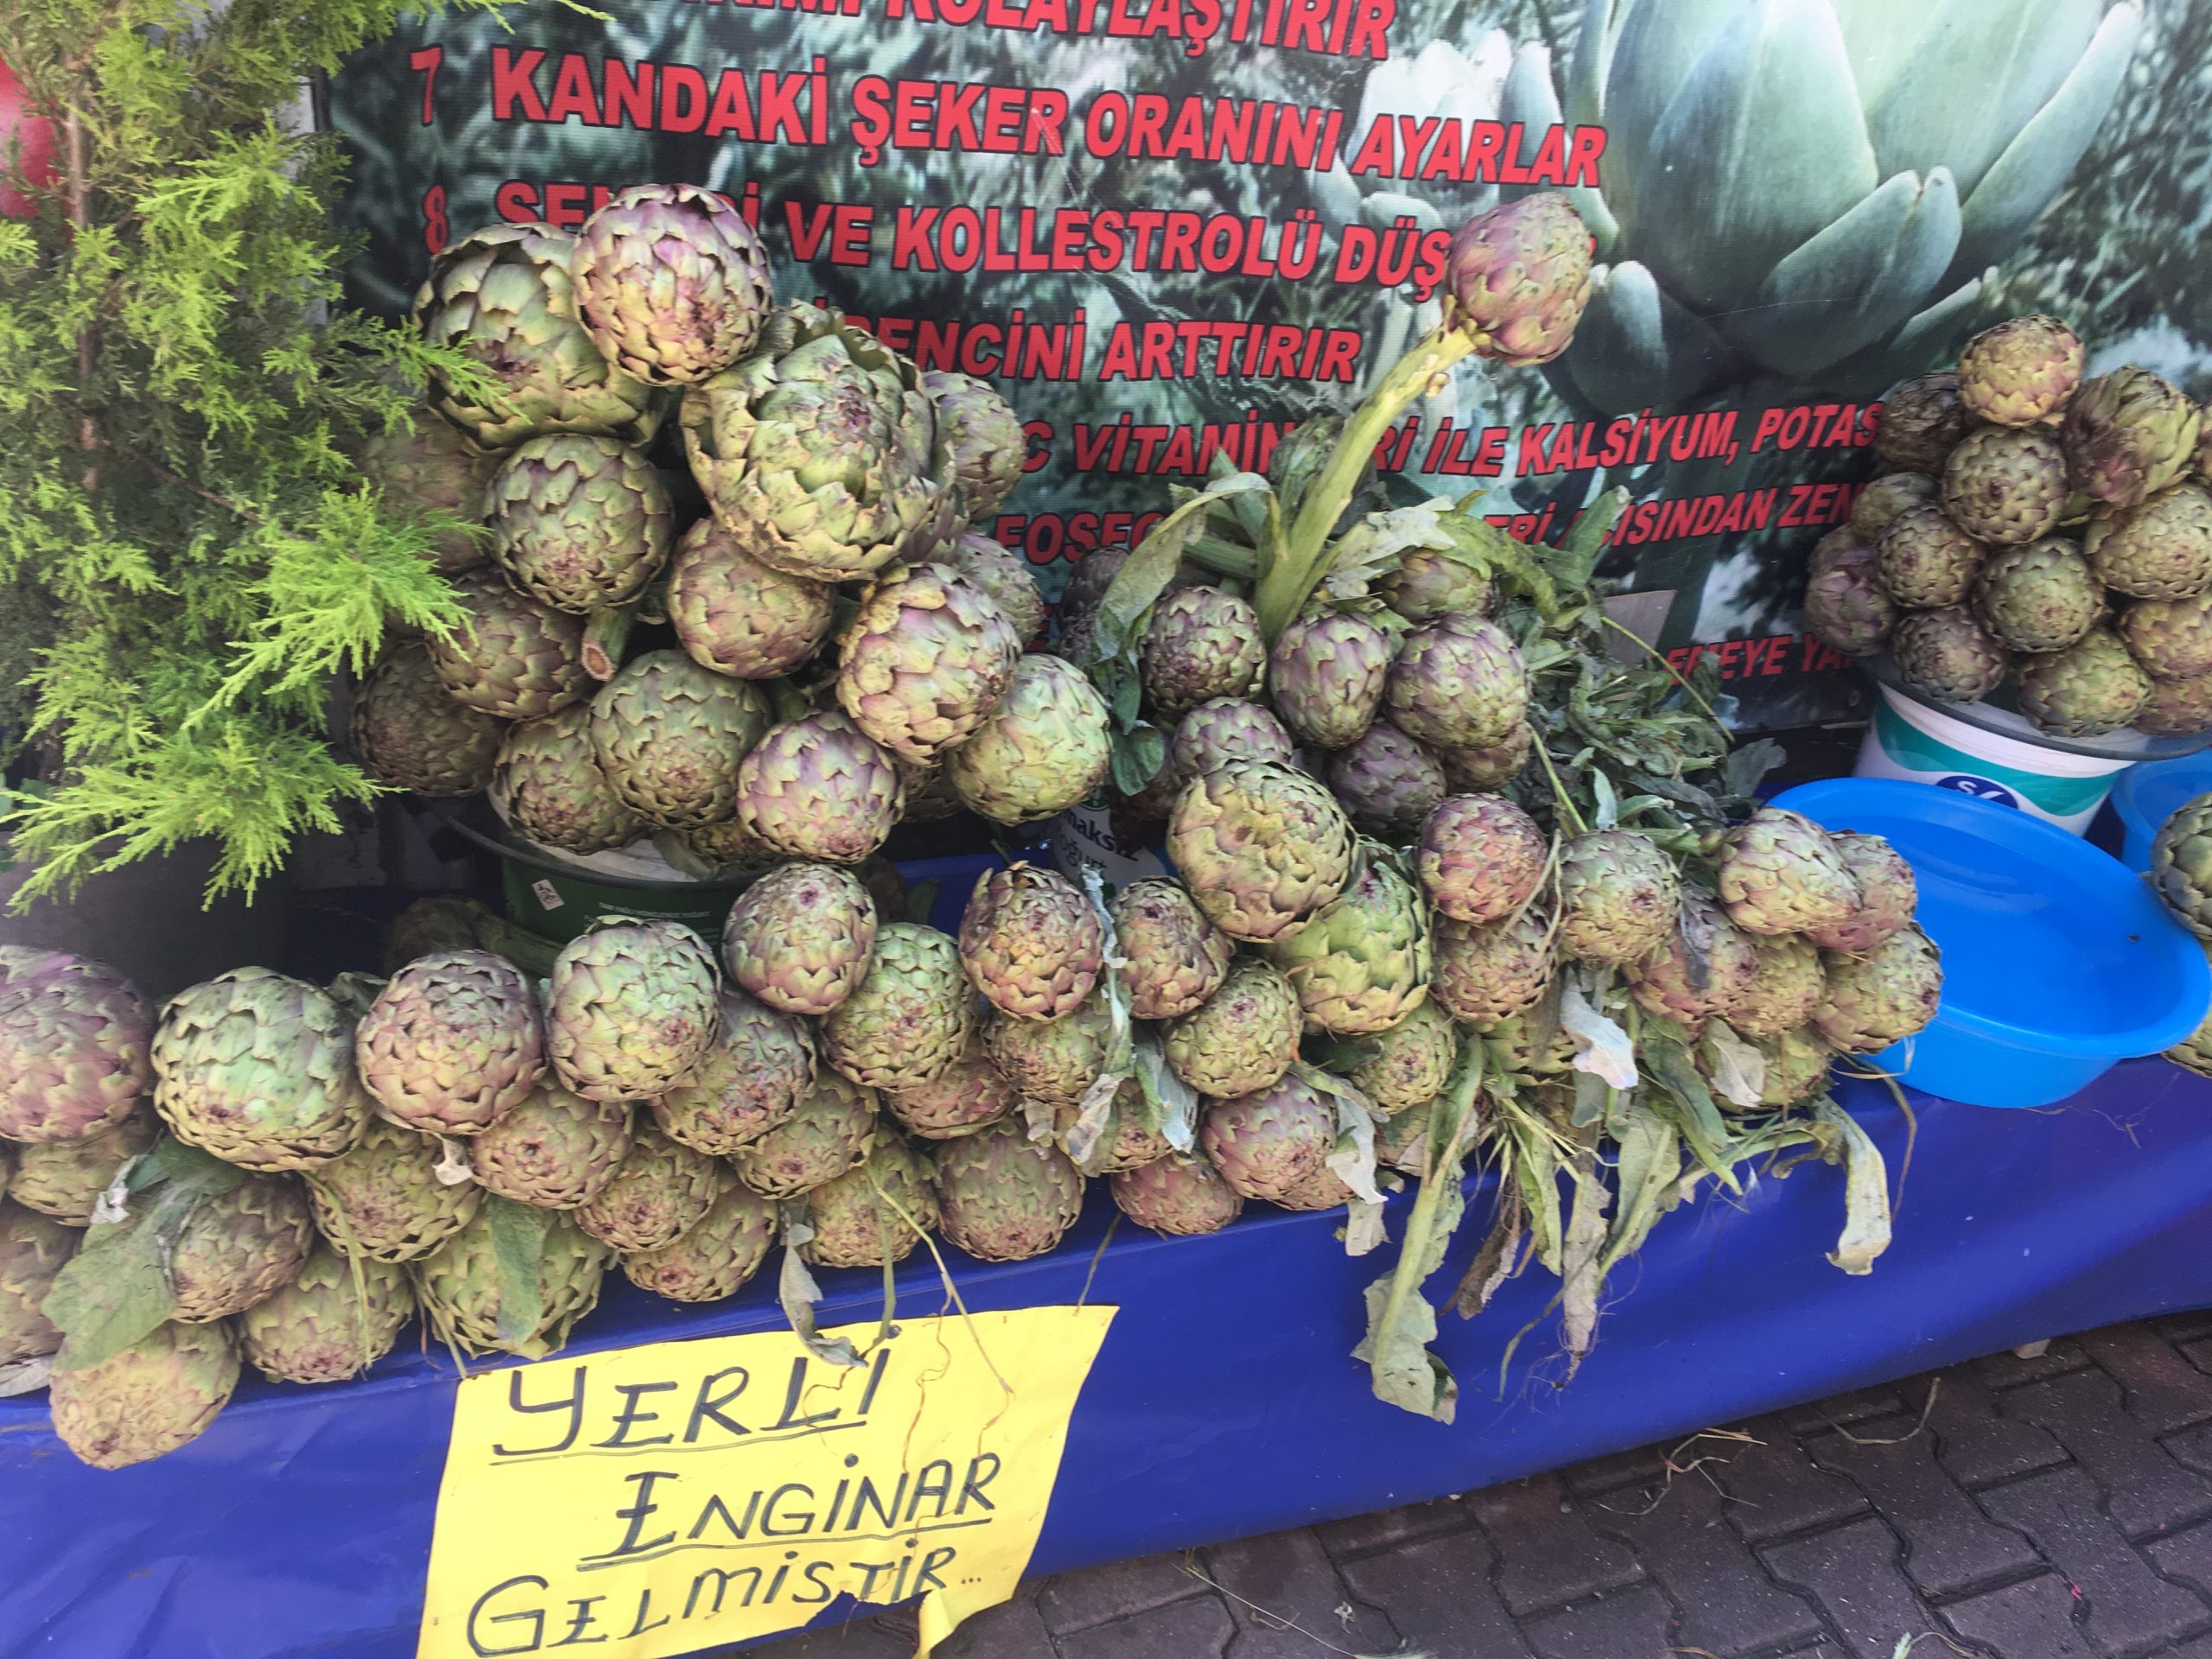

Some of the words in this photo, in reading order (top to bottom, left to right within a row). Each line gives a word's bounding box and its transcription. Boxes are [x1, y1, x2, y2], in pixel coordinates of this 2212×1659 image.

[410, 46, 443, 126] 7
[491, 46, 830, 146] KANDAKİ
[850, 75, 1070, 168] ŞEKER
[1085, 90, 1344, 173] ORANINI
[1352, 113, 1608, 188] AYARLAR
[423, 183, 449, 256] 8
[784, 200, 874, 267] VE
[891, 204, 1324, 281] KOLLESTROLÜ
[1098, 321, 1363, 383] ARTTIRIR
[1421, 415, 1510, 477] İLE
[1515, 406, 1741, 478] KALSİYUM,
[1749, 400, 1885, 454] POTAS
[1775, 482, 1866, 529] ZEN
[580, 1452, 1001, 1561] ENGİNAR
